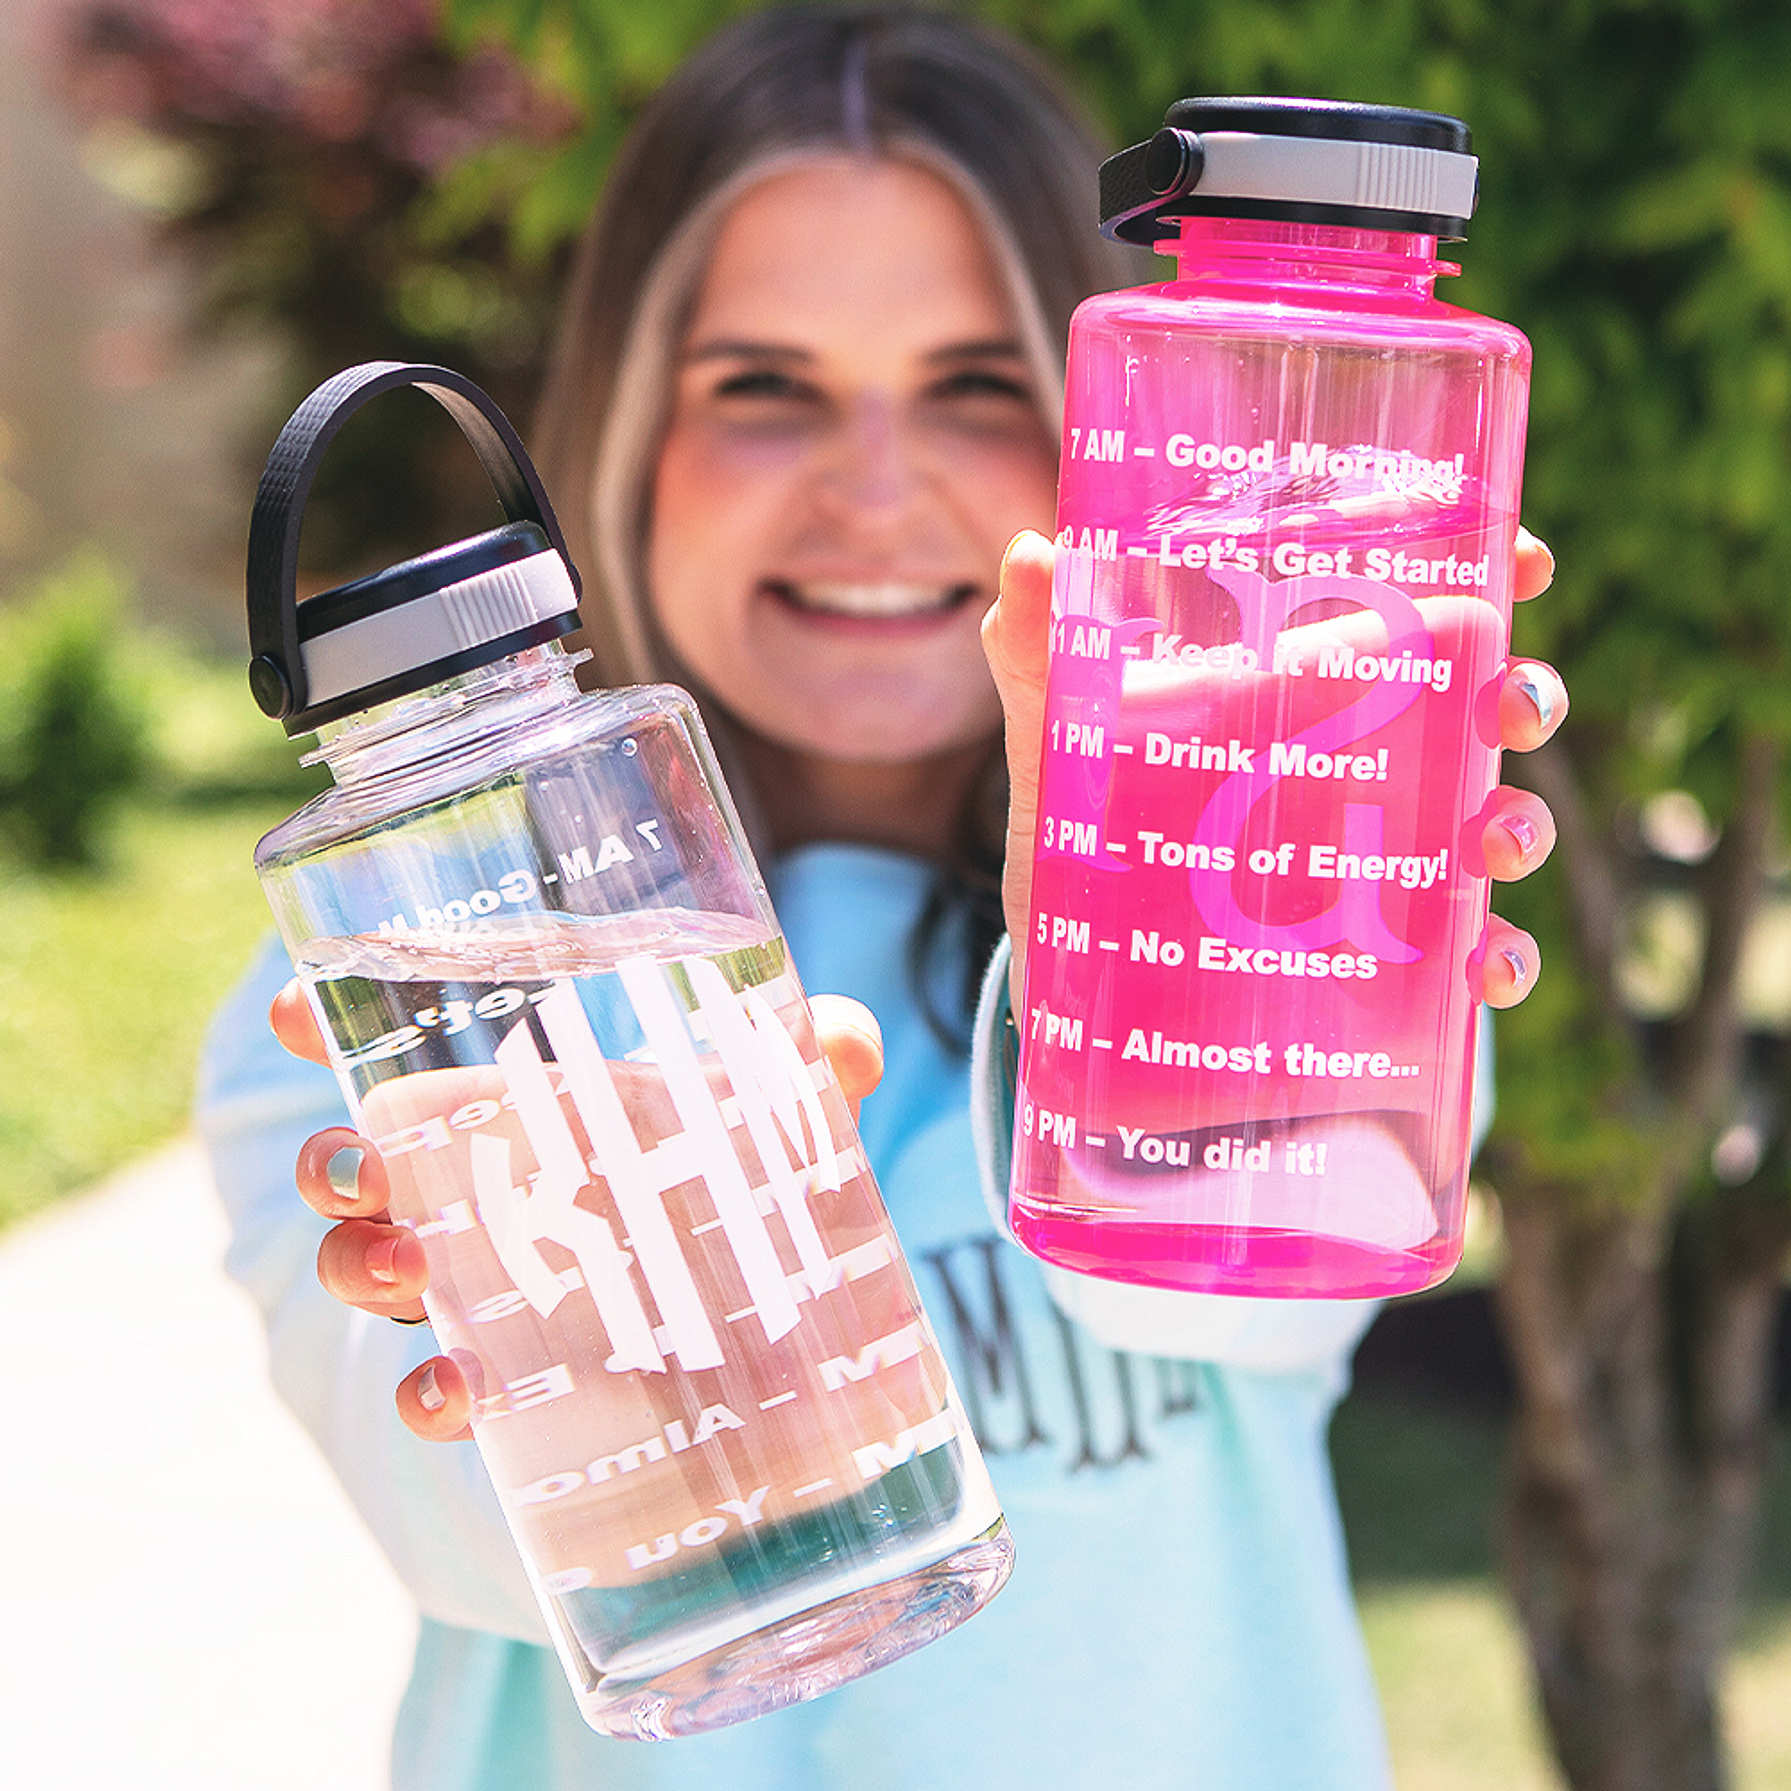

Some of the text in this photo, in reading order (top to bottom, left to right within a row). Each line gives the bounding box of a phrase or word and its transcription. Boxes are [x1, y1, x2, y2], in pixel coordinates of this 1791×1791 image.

[1070, 427, 1081, 460] 7
[1083, 429, 1125, 463] AM
[1166, 434, 1273, 474] Good
[1289, 443, 1465, 487] Morning!
[1077, 526, 1118, 563] AM
[1273, 542, 1352, 580] Get
[1364, 554, 1490, 588] Started
[1069, 624, 1112, 660] AM
[1152, 634, 1258, 680] Keep
[1272, 642, 1304, 677] it
[1318, 649, 1452, 693] Moving
[1051, 723, 1061, 752] 1
[1065, 723, 1105, 759] PM
[1144, 732, 1255, 774] Drink
[1268, 743, 1389, 781] More!
[1043, 816, 1055, 849] 3
[1058, 819, 1097, 857] PM
[1137, 831, 1235, 872] Tons
[1248, 840, 1295, 878] of
[1307, 846, 1448, 889] Energy!
[1037, 913, 1047, 945] 5
[1051, 916, 1090, 954] PM
[1130, 929, 1185, 967] No
[1198, 938, 1378, 979] Excuses
[1031, 1008, 1043, 1041] 7
[1045, 1012, 1083, 1051] PM
[1121, 1028, 1272, 1074] Almost
[1284, 1043, 1421, 1078] there...
[1023, 1103, 1034, 1138] 9
[1037, 1109, 1076, 1149] PM
[1117, 1126, 1190, 1167] You
[1203, 1136, 1270, 1173] did
[1284, 1142, 1328, 1177] it!
